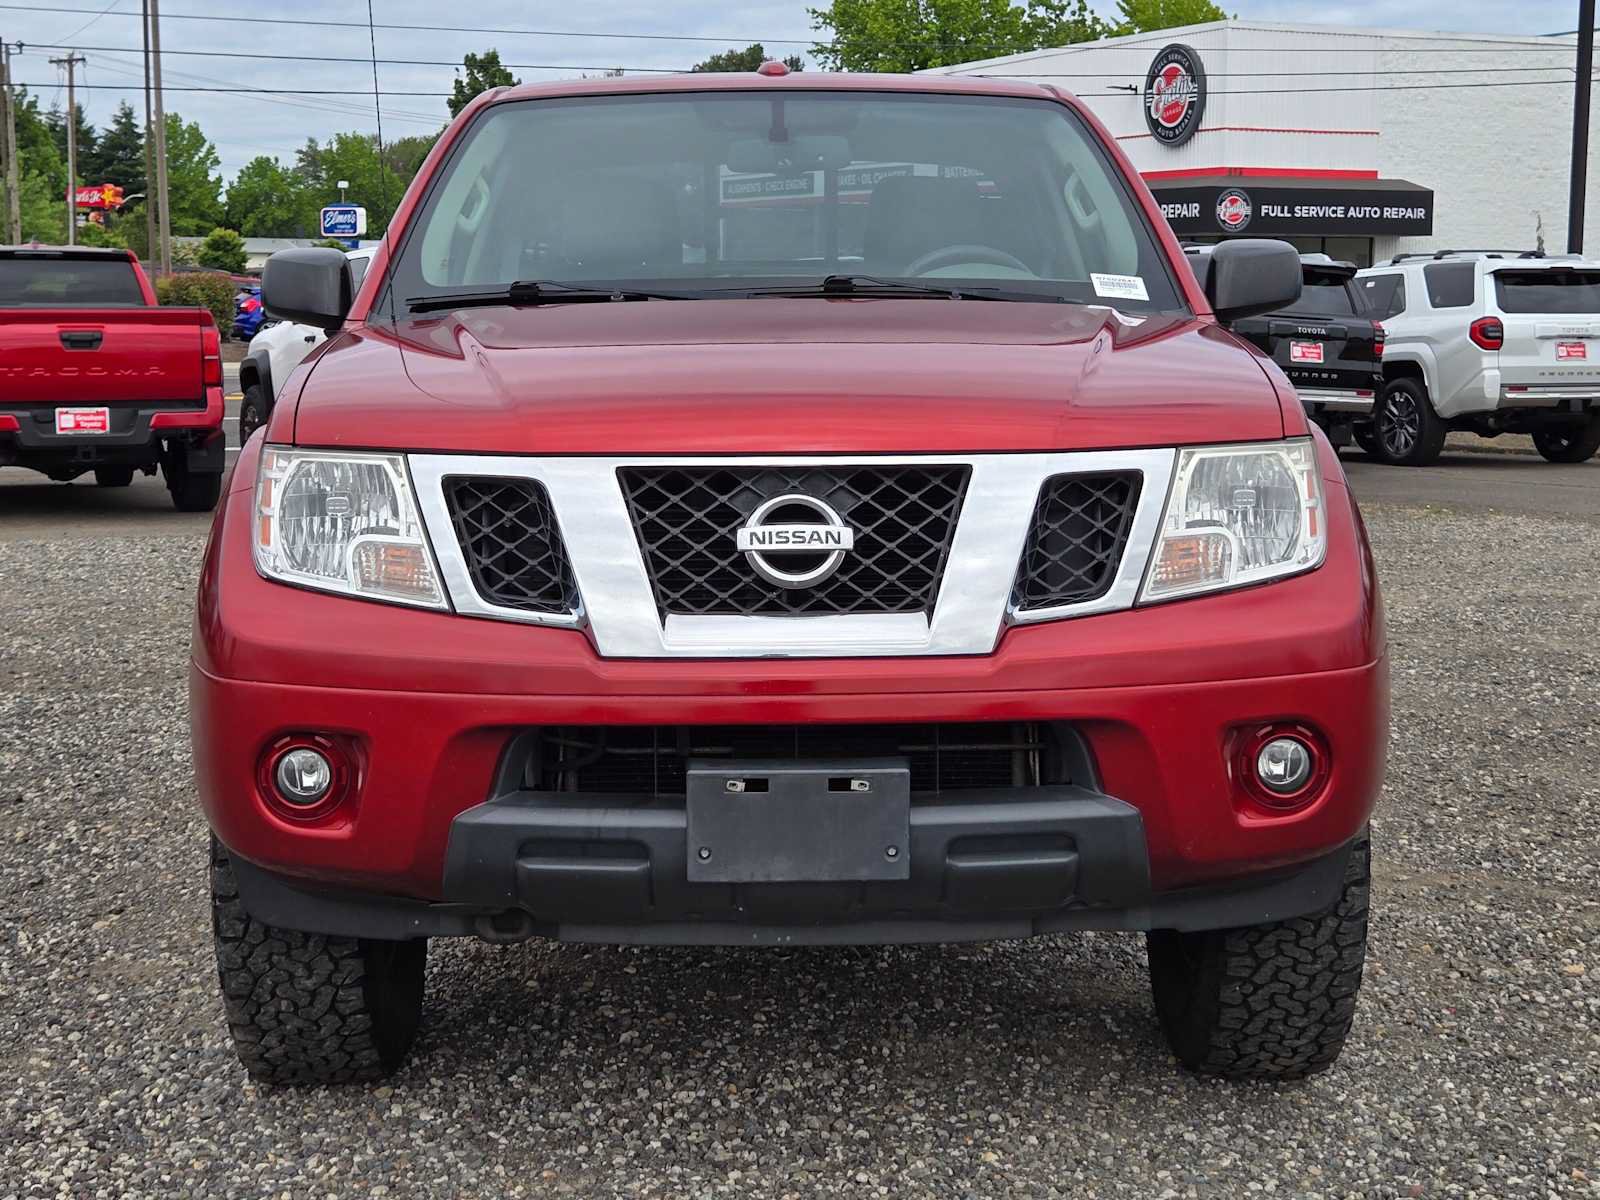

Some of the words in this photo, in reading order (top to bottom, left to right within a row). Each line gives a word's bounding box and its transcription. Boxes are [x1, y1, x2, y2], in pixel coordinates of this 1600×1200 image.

[1151, 72, 1194, 119] Emily's
[1157, 127, 1174, 138] AUTO
[325, 210, 356, 228] Elmer's
[1260, 204, 1292, 217] FULL
[1294, 205, 1345, 218] SERVICE
[1347, 206, 1381, 219] AUTO
[1383, 207, 1425, 219] REPAIR
[1297, 326, 1327, 336] TOYOTA
[749, 530, 841, 545] NISSAN
